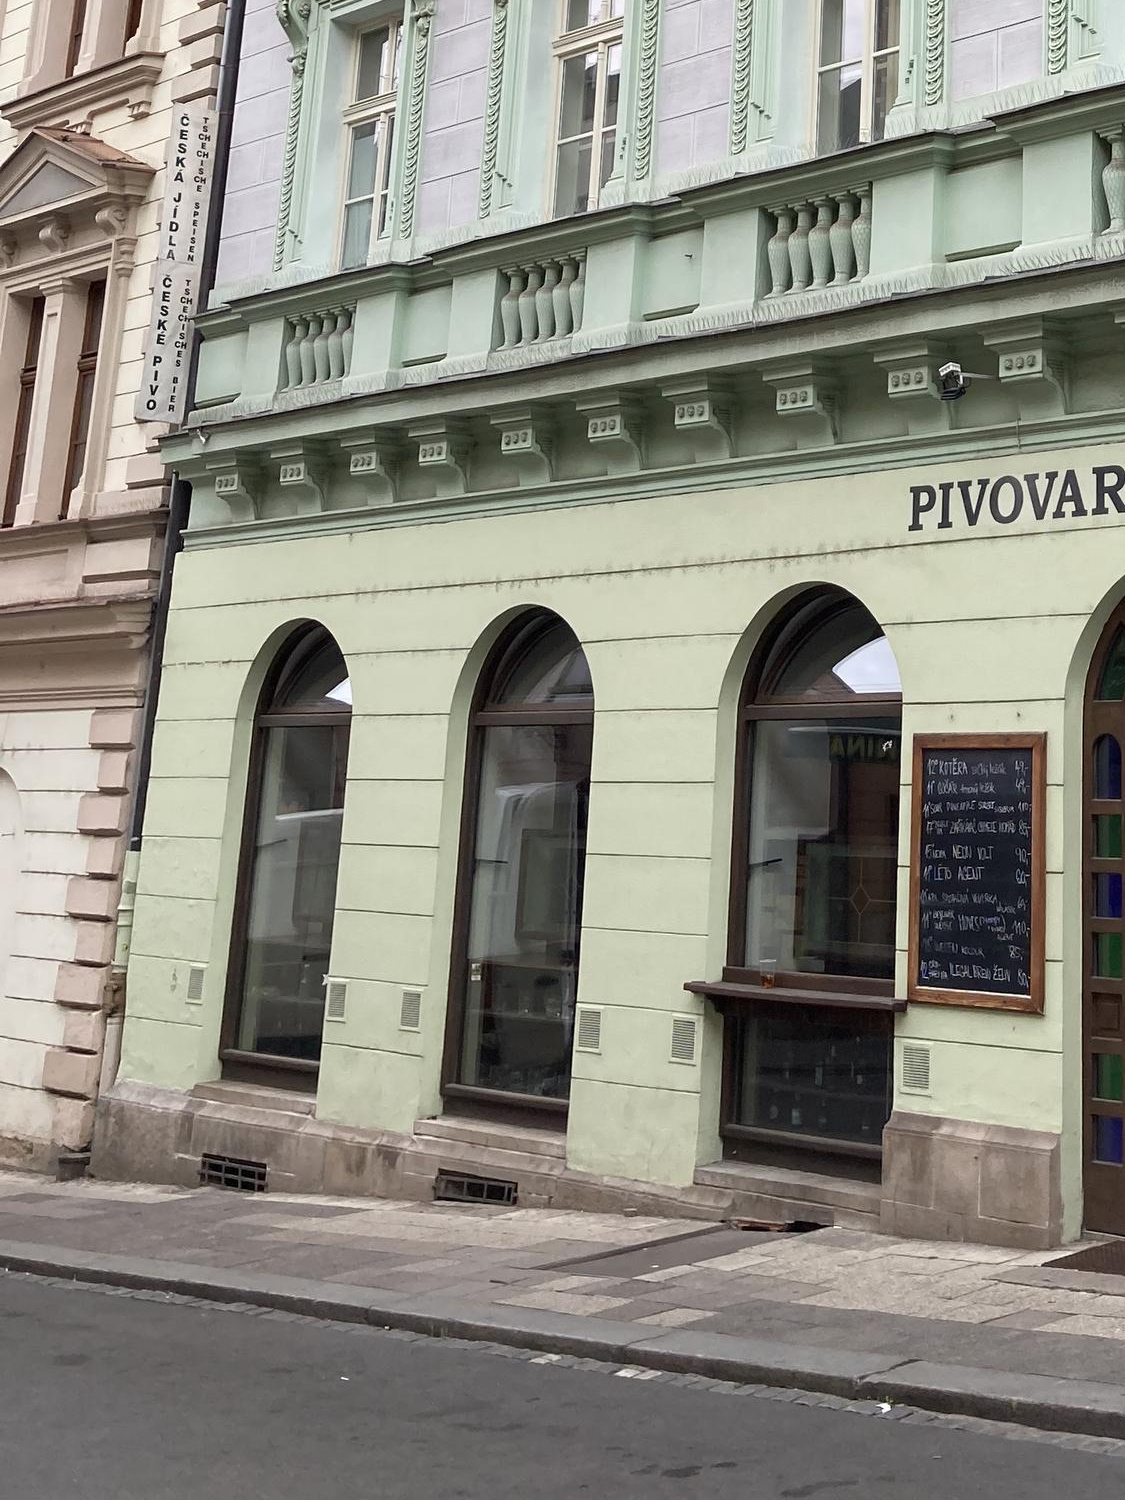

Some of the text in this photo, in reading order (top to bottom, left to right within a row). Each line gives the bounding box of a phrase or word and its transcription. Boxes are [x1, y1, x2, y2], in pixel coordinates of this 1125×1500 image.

[166, 113, 190, 261] ČESKÁ JÍDLA
[187, 116, 211, 262] TSCHECHISCHE SPEISEN
[146, 275, 173, 411] ČESKÉ PIVO
[168, 377, 179, 413] BIER
[939, 757, 968, 775] KOTĚRA
